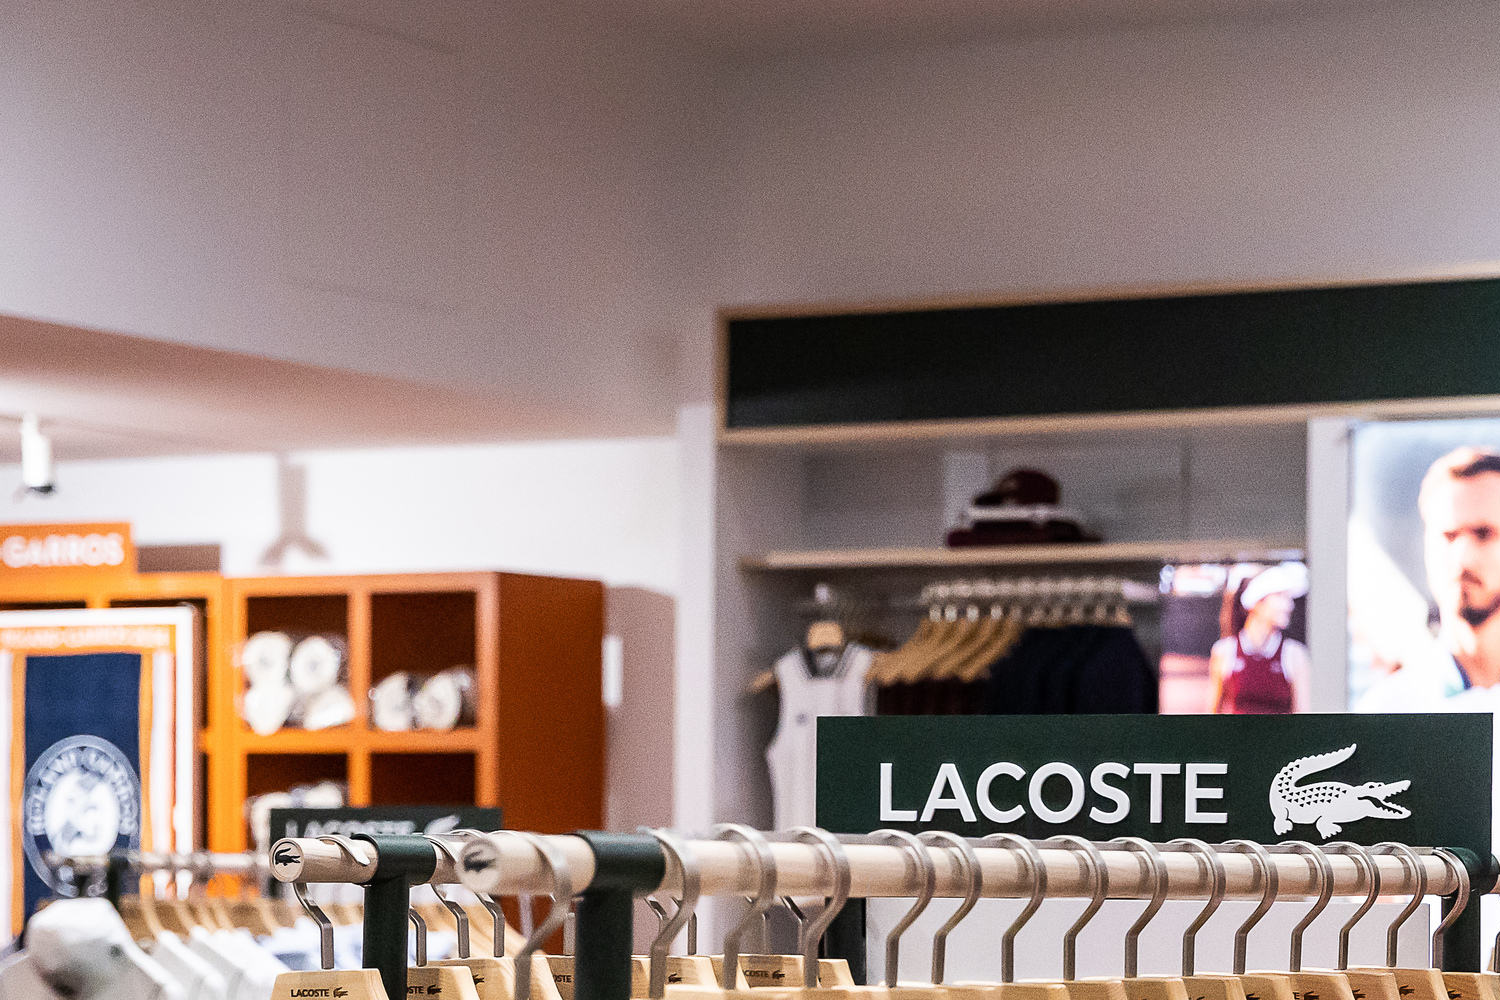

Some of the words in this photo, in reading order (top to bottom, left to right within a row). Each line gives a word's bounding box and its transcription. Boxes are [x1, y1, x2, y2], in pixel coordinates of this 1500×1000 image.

[880, 762, 1228, 824] LACOSTE
[744, 969, 769, 977] COSTE
[290, 988, 329, 997] LACOSTE
